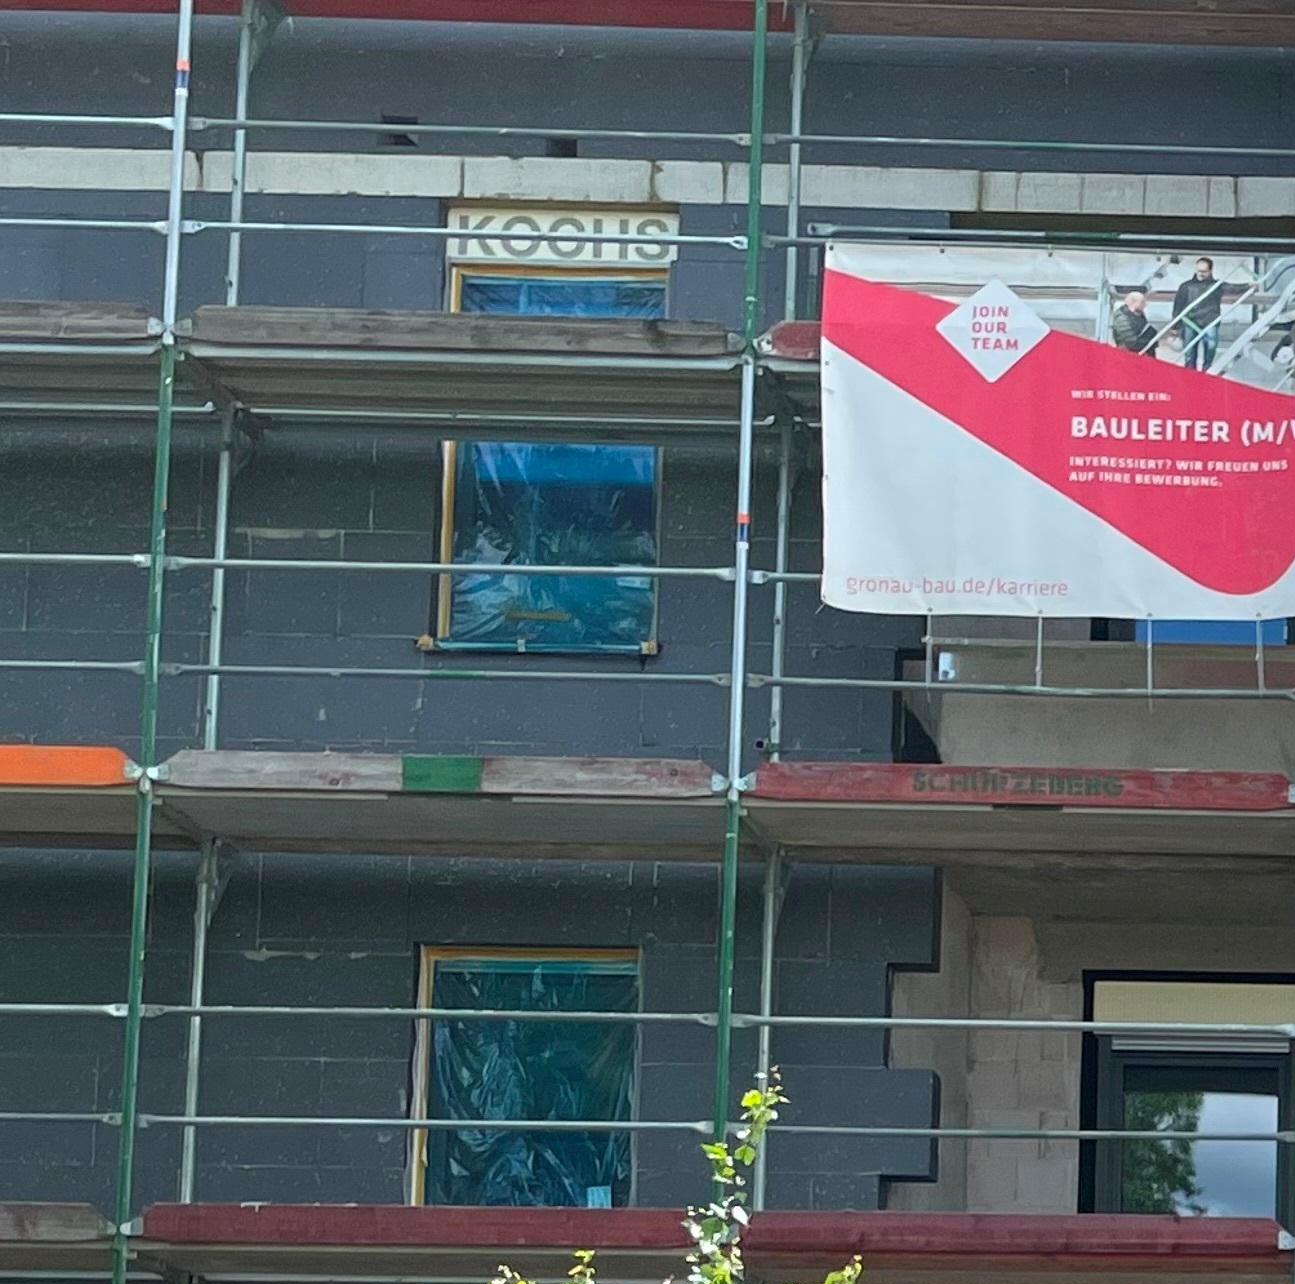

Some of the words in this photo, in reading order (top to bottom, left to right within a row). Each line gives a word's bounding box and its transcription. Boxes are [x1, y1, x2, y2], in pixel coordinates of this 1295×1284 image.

[458, 215, 671, 261] KOCHS
[972, 306, 1009, 320] JOIN
[972, 321, 1007, 334] OUR
[971, 337, 1019, 350] TEAM
[1071, 390, 1093, 400] WIR
[1071, 416, 1230, 442] BAULEITER
[1069, 456, 1172, 470] INTERESSIERT?
[1176, 460, 1203, 471] WIR
[1207, 460, 1259, 472] FREUEN
[1263, 459, 1288, 471] UNS
[1069, 471, 1095, 482] AUF
[1099, 472, 1131, 484] IHRE
[1135, 473, 1224, 487] BEWERBUNG.
[846, 576, 1068, 597] gronau-bau.de/karriere
